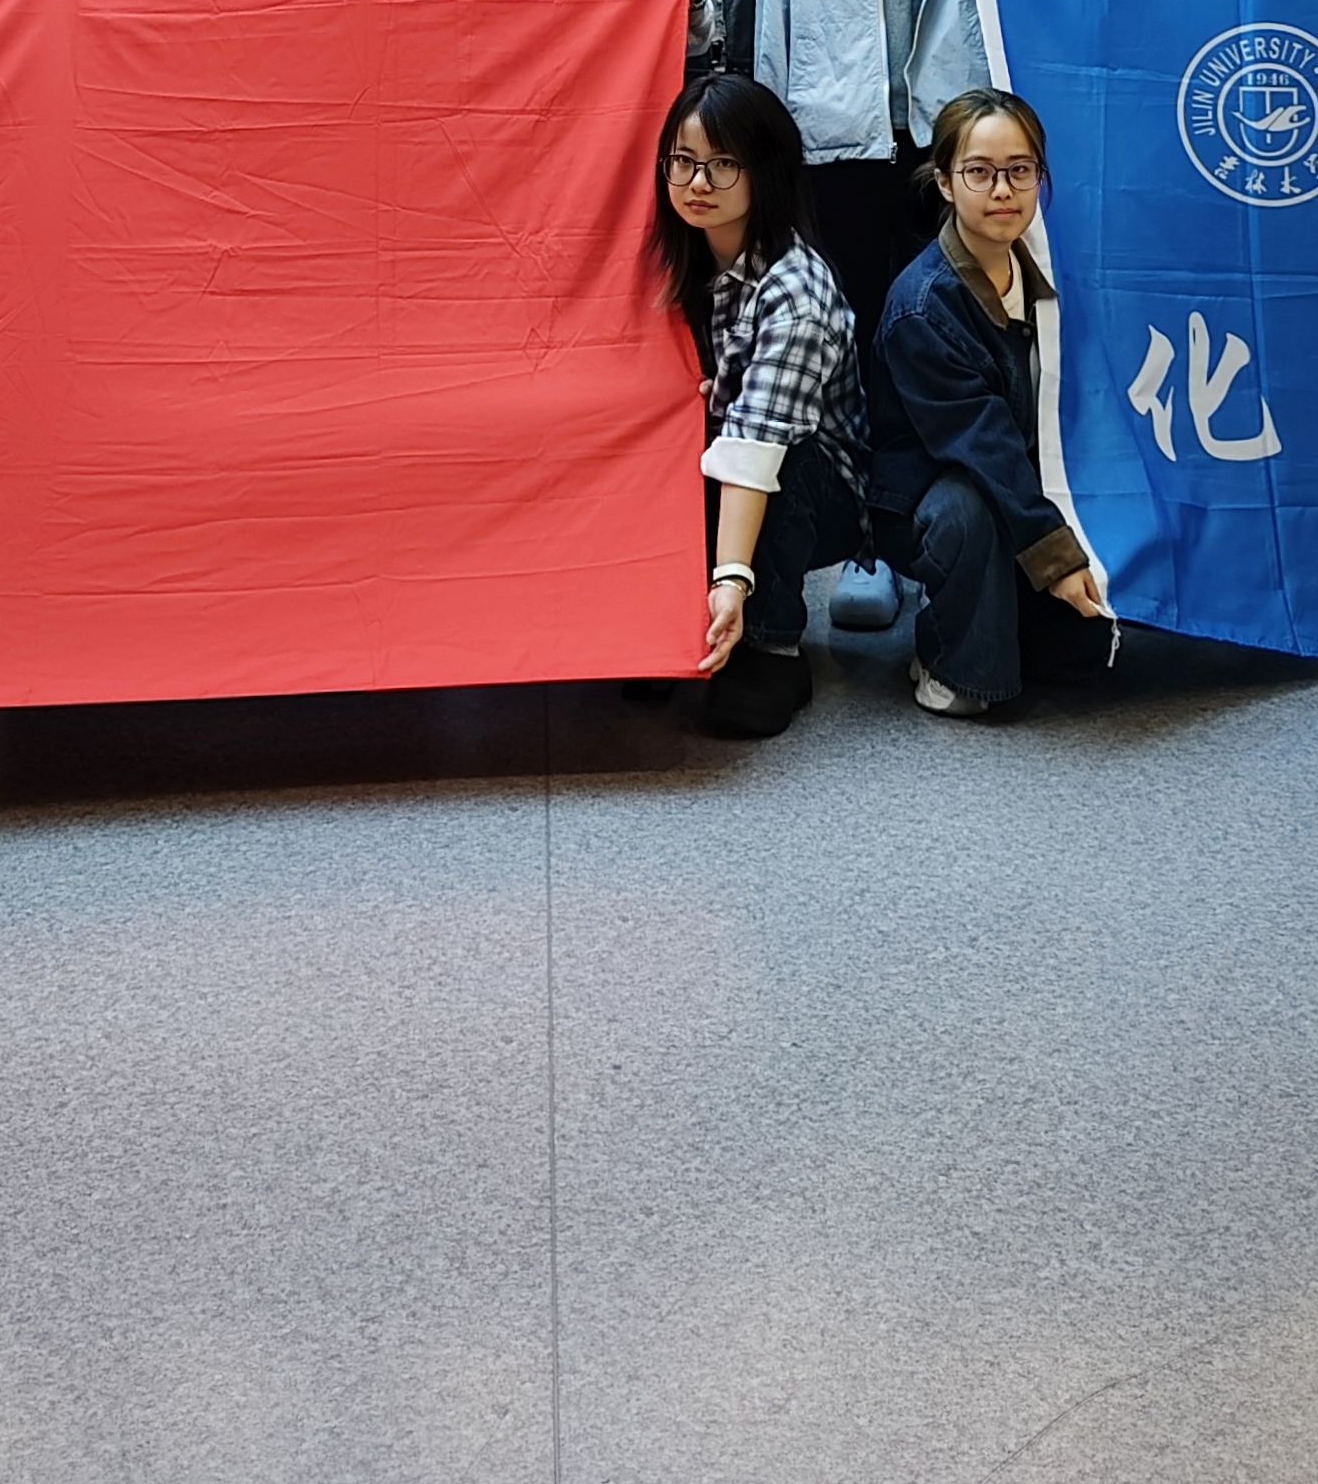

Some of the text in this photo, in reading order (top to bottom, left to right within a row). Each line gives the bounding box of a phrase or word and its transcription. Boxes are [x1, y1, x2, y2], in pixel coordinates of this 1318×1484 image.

[1199, 37, 1316, 87] UNIVERSITY
[1245, 72, 1290, 86] 1946
[1191, 89, 1216, 136] JILIN
